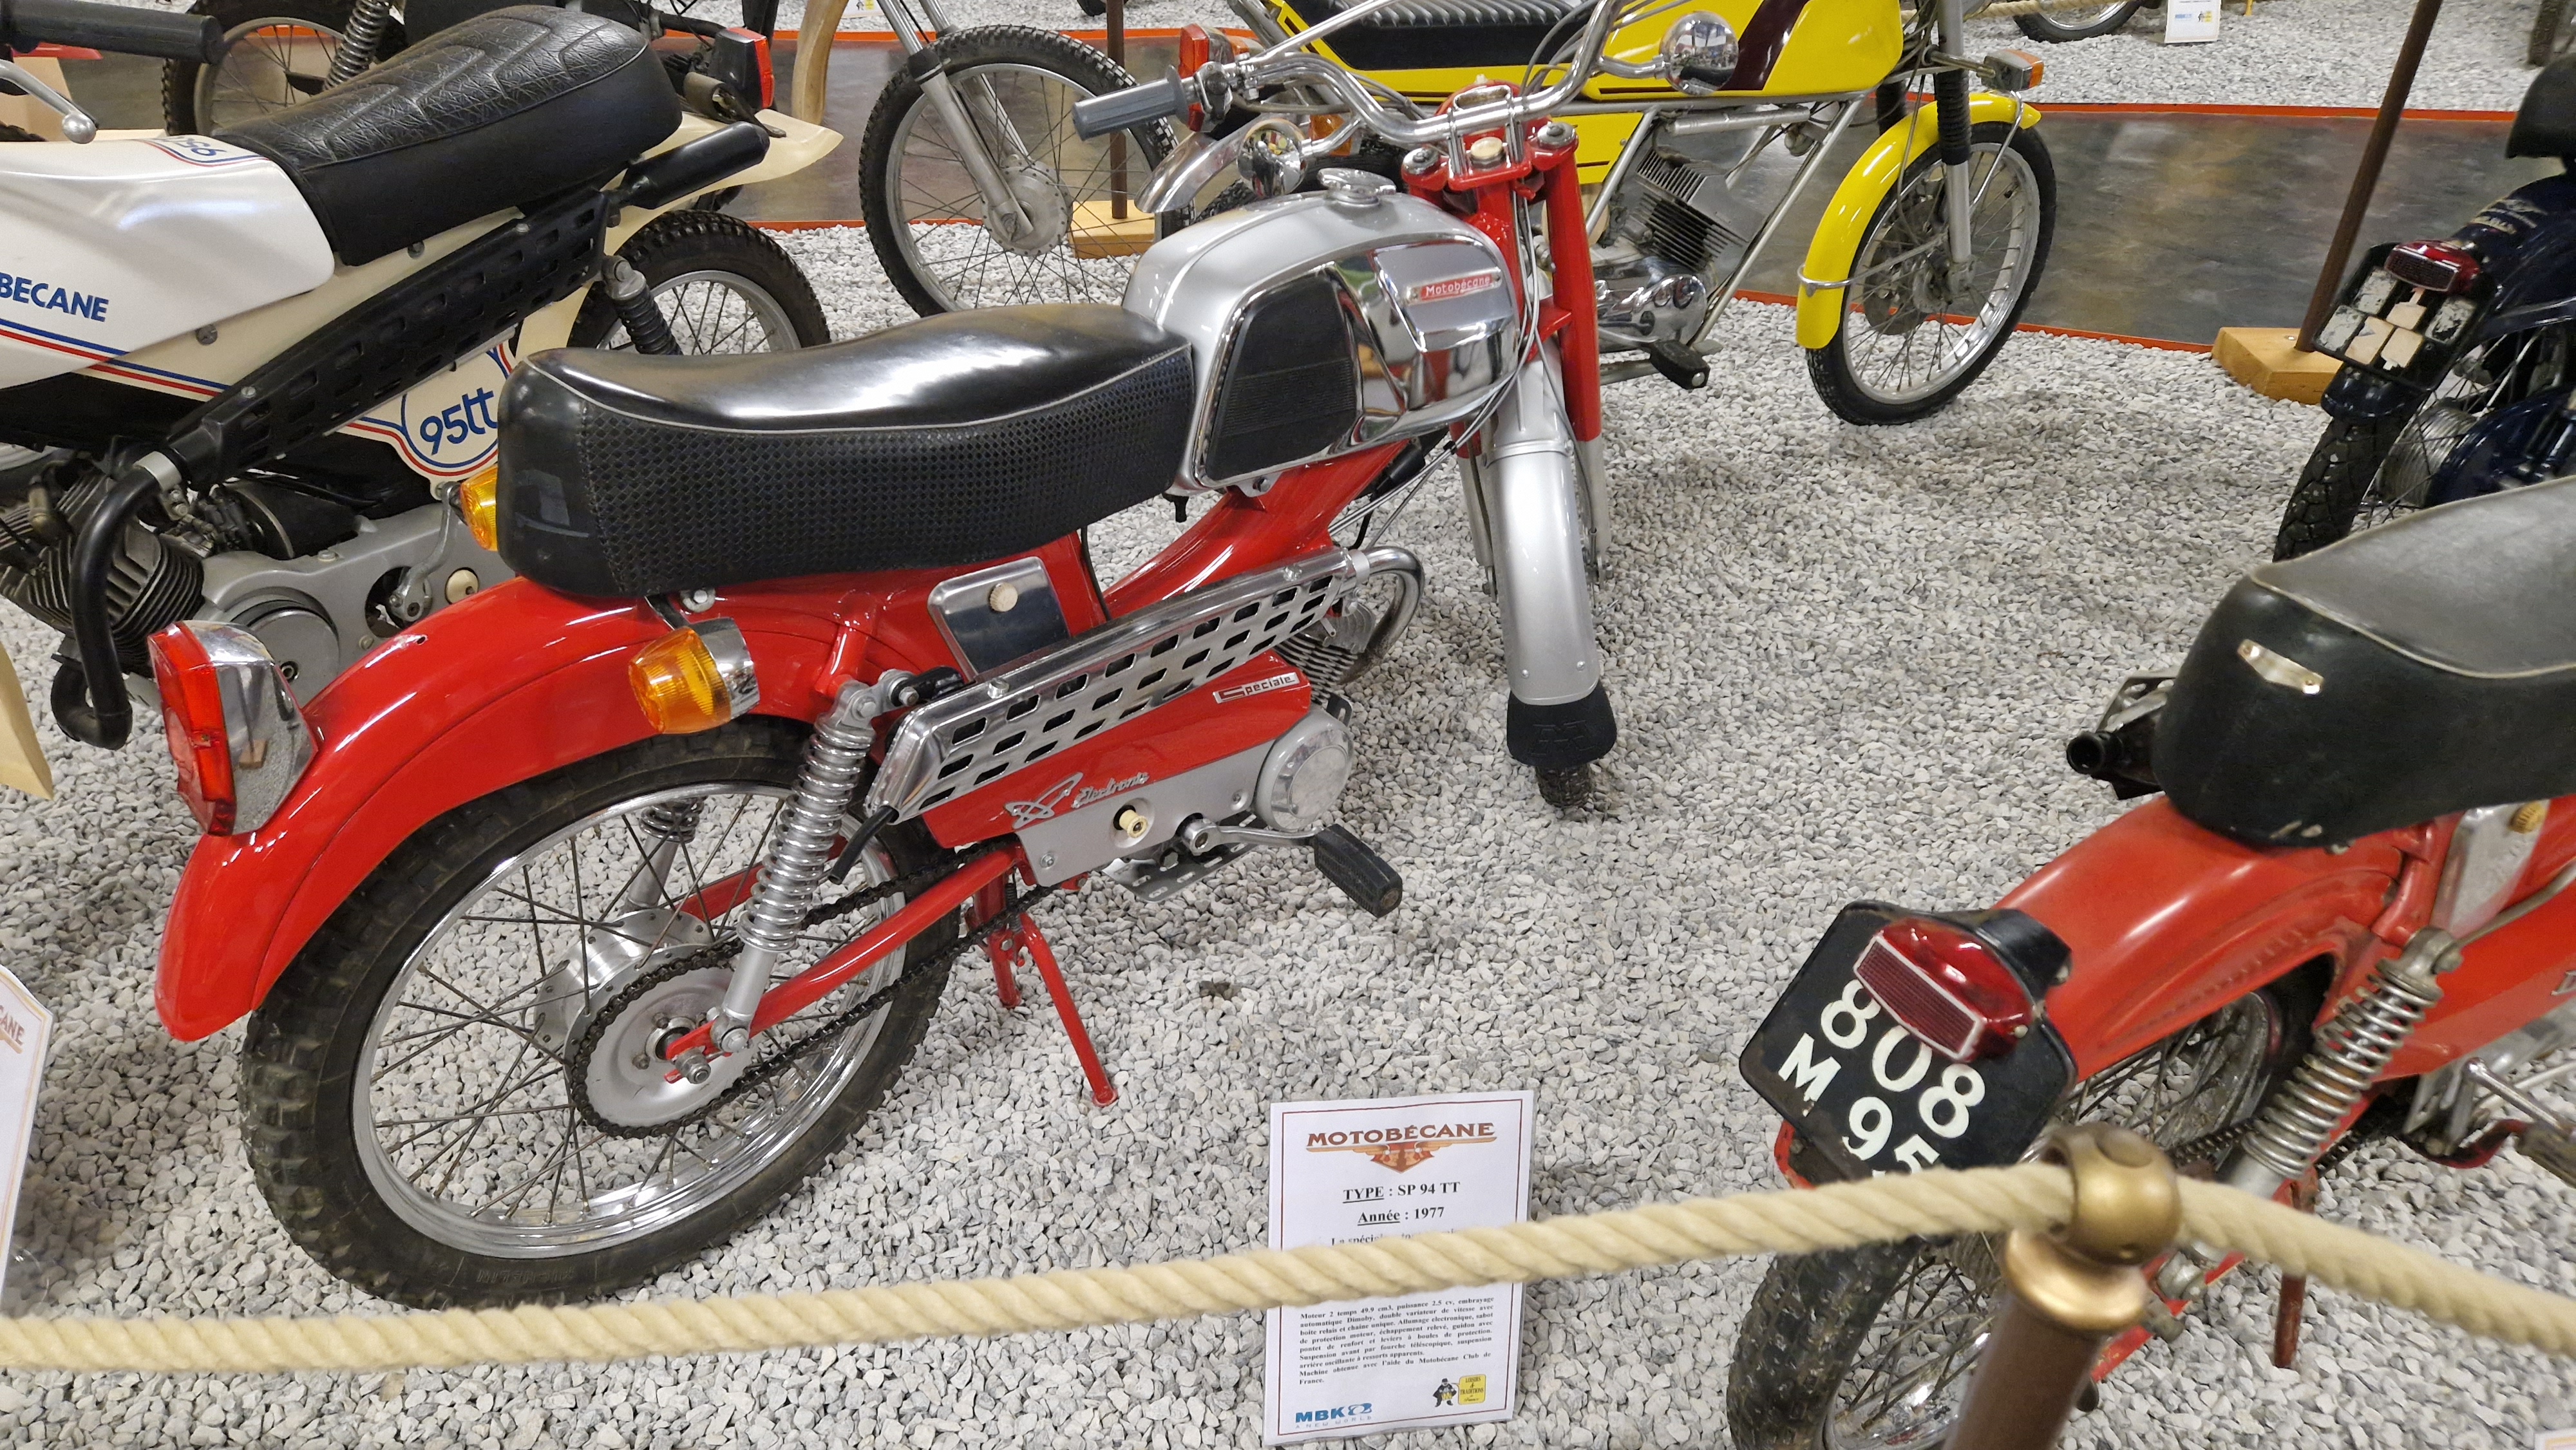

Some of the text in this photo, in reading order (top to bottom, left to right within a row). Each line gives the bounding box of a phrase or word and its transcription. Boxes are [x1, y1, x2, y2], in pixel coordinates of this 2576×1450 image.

[1425, 277, 1491, 297] Motobécane
[420, 388, 498, 455] 95tt
[0, 1004, 24, 1046] ANE
[1778, 1033, 1842, 1102] M
[1820, 979, 1985, 1139] 808
[1307, 1123, 1495, 1146] MOTOBÉCANE
[1343, 1187, 1385, 1203] TYPE
[1397, 1184, 1416, 1196] SP
[1420, 1183, 1435, 1195] 94
[1440, 1182, 1460, 1193] TT
[1358, 1210, 1401, 1225] Année
[1414, 1207, 1444, 1219] 1977
[1397, 1302, 1428, 1310] puissance
[1312, 1335, 1346, 1344] protection
[1379, 1326, 1423, 1335] échappement
[1457, 1329, 1492, 1338] protection.
[1300, 1352, 1337, 1361] Suspension
[1457, 1337, 1492, 1345] suspension
[1325, 1357, 1355, 1366] oscillante
[1295, 1406, 1345, 1423] MBK
